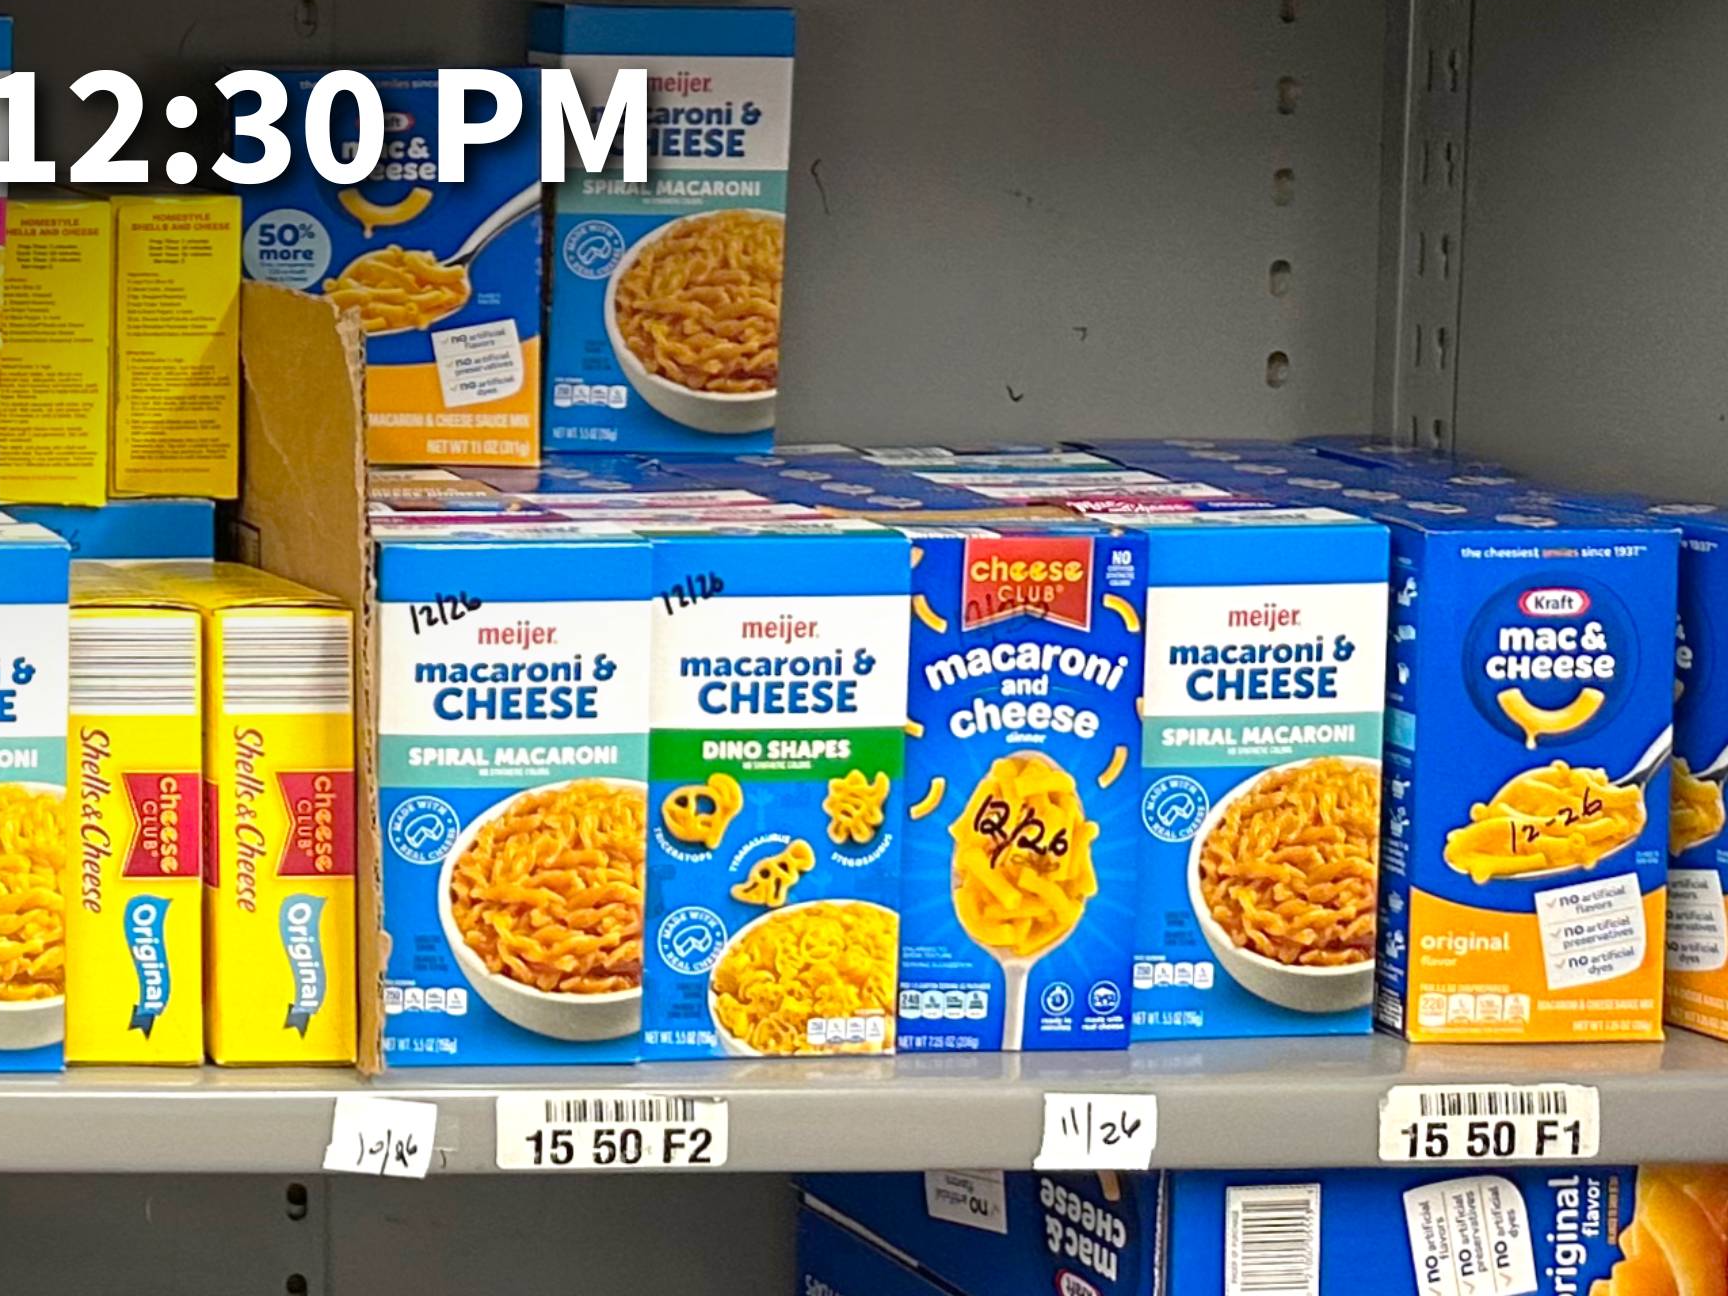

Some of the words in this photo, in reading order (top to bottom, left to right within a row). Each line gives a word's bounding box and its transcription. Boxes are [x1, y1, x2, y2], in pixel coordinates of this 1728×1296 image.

[581, 179, 652, 197] SPIRAL
[657, 179, 762, 197] MACARONI
[259, 224, 315, 246] 50%
[259, 249, 313, 260] more
[702, 740, 762, 761] DINO
[767, 738, 852, 760] SHAPES
[132, 903, 164, 1010] Original
[524, 1132, 574, 1166] 15
[592, 1129, 642, 1165] 50
[661, 1128, 713, 1164] F2
[1400, 1122, 1449, 1158] 15
[1466, 1121, 1516, 1158] 50
[1536, 1119, 1582, 1156] F1
